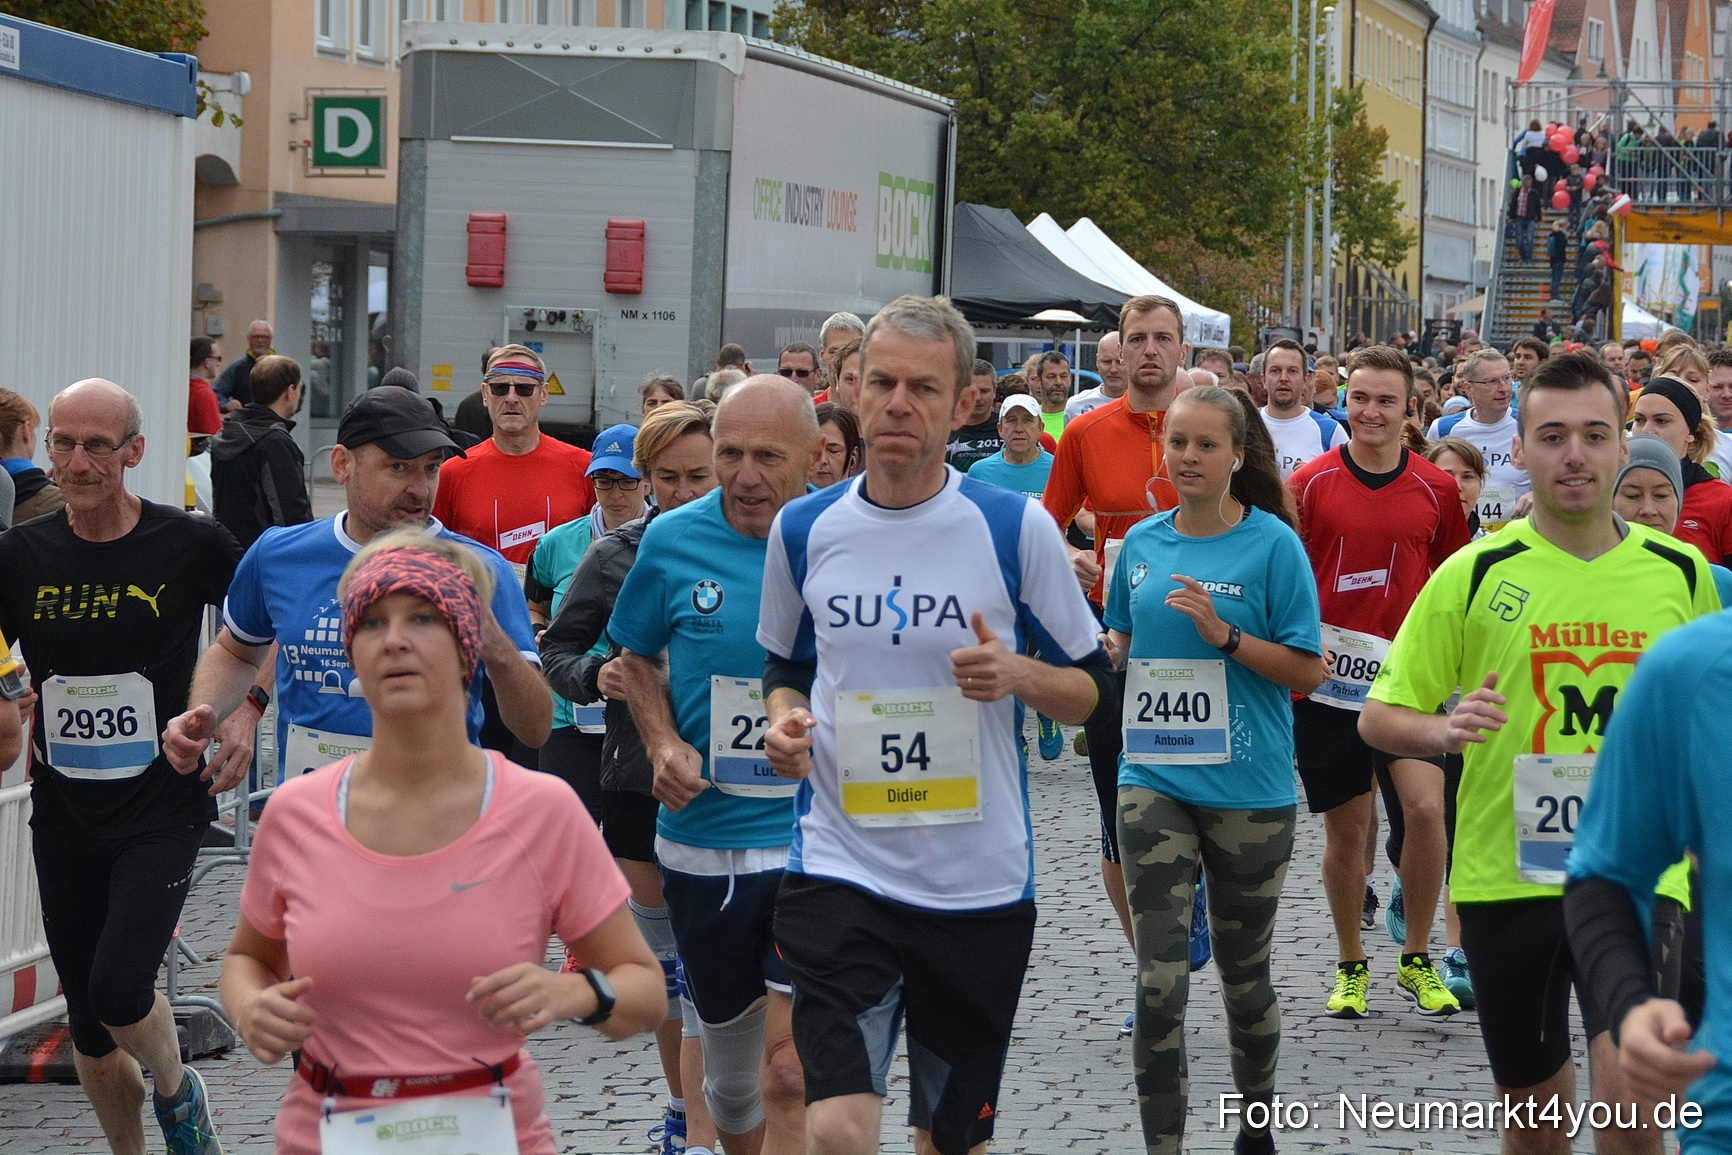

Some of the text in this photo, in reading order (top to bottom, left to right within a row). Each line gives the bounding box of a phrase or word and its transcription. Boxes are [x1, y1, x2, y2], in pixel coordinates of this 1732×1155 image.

[324, 107, 373, 157] D
[753, 177, 858, 232] OFFICE INDUSTRY LOUNGE
[876, 176, 933, 268] BOCK
[621, 309, 638, 319] NM
[652, 311, 676, 320] 1106
[976, 439, 1005, 448] 2017
[512, 529, 533, 541] DEHN
[1350, 575, 1373, 585] DEHN
[1198, 580, 1244, 597] OCK
[34, 584, 120, 620] RUN
[827, 585, 968, 636] SUSPA
[1528, 622, 1648, 648] Müller
[300, 645, 345, 656] Neumar
[1346, 637, 1374, 649] BOCK
[1157, 668, 1194, 678] BOCK
[78, 685, 119, 696] BOCK
[1331, 683, 1360, 697] Patrick
[885, 701, 934, 714] BOCK
[1137, 691, 1211, 723] 2440
[1558, 685, 1619, 737] M
[57, 706, 138, 740] 2936
[1154, 734, 1195, 746] Antonia
[881, 731, 931, 773] 54
[887, 788, 929, 802] Didier
[394, 1115, 460, 1136] BOCK
